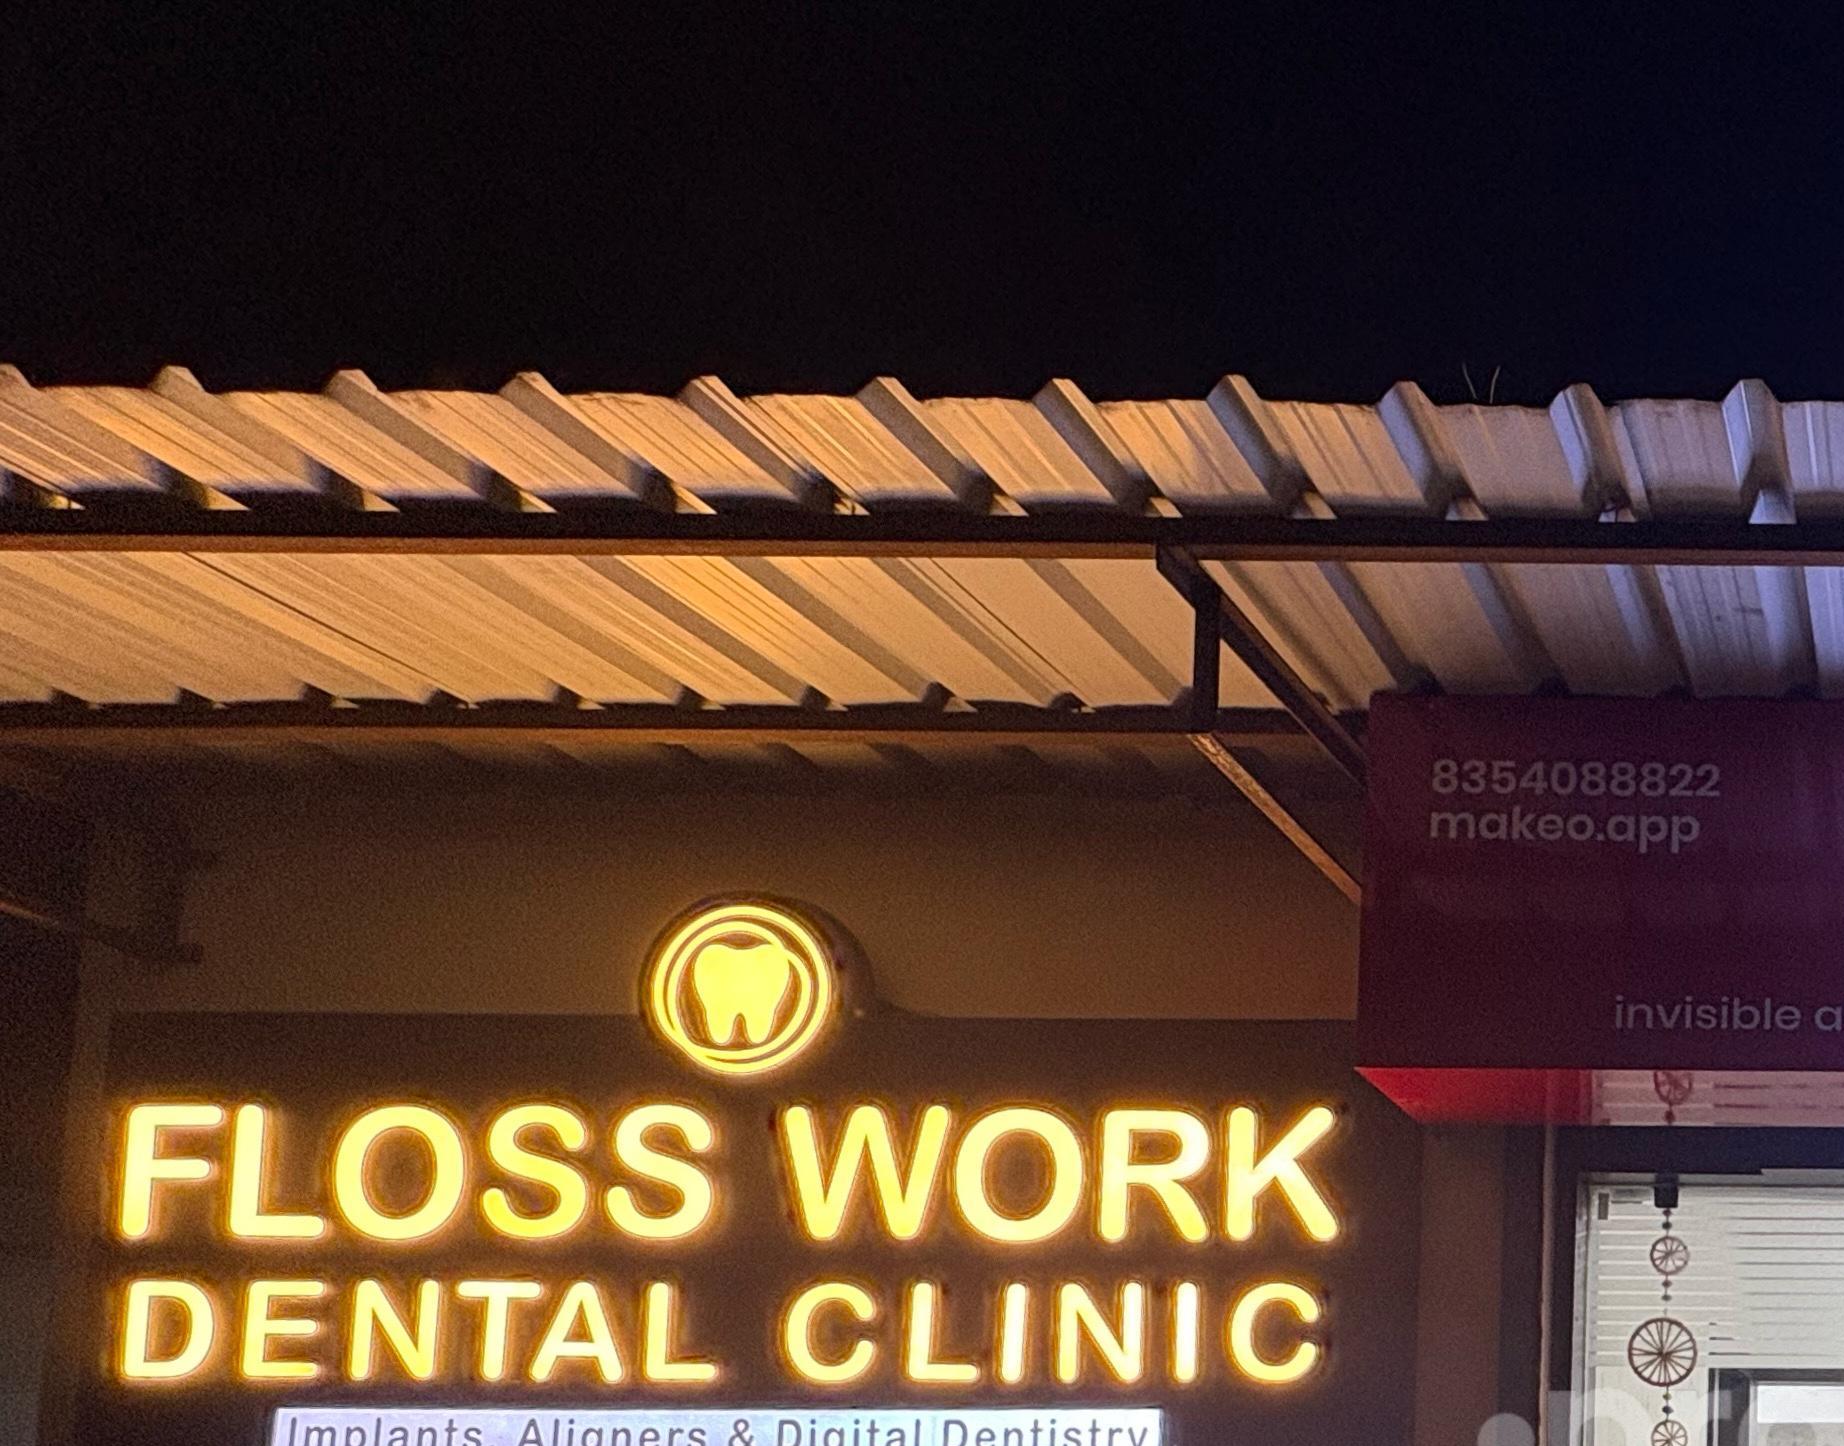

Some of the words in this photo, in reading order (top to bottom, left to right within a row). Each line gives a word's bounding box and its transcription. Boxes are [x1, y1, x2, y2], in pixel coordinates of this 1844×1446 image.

[1431, 758, 1721, 797] 8354088822
[1430, 805, 1700, 853] makeo.app
[1615, 995, 1800, 1031] invisible
[120, 1103, 713, 1240] FLOSS
[785, 1105, 1340, 1243] WORK
[121, 1279, 718, 1383] DENTAL
[786, 1282, 1320, 1384] CLINIC
